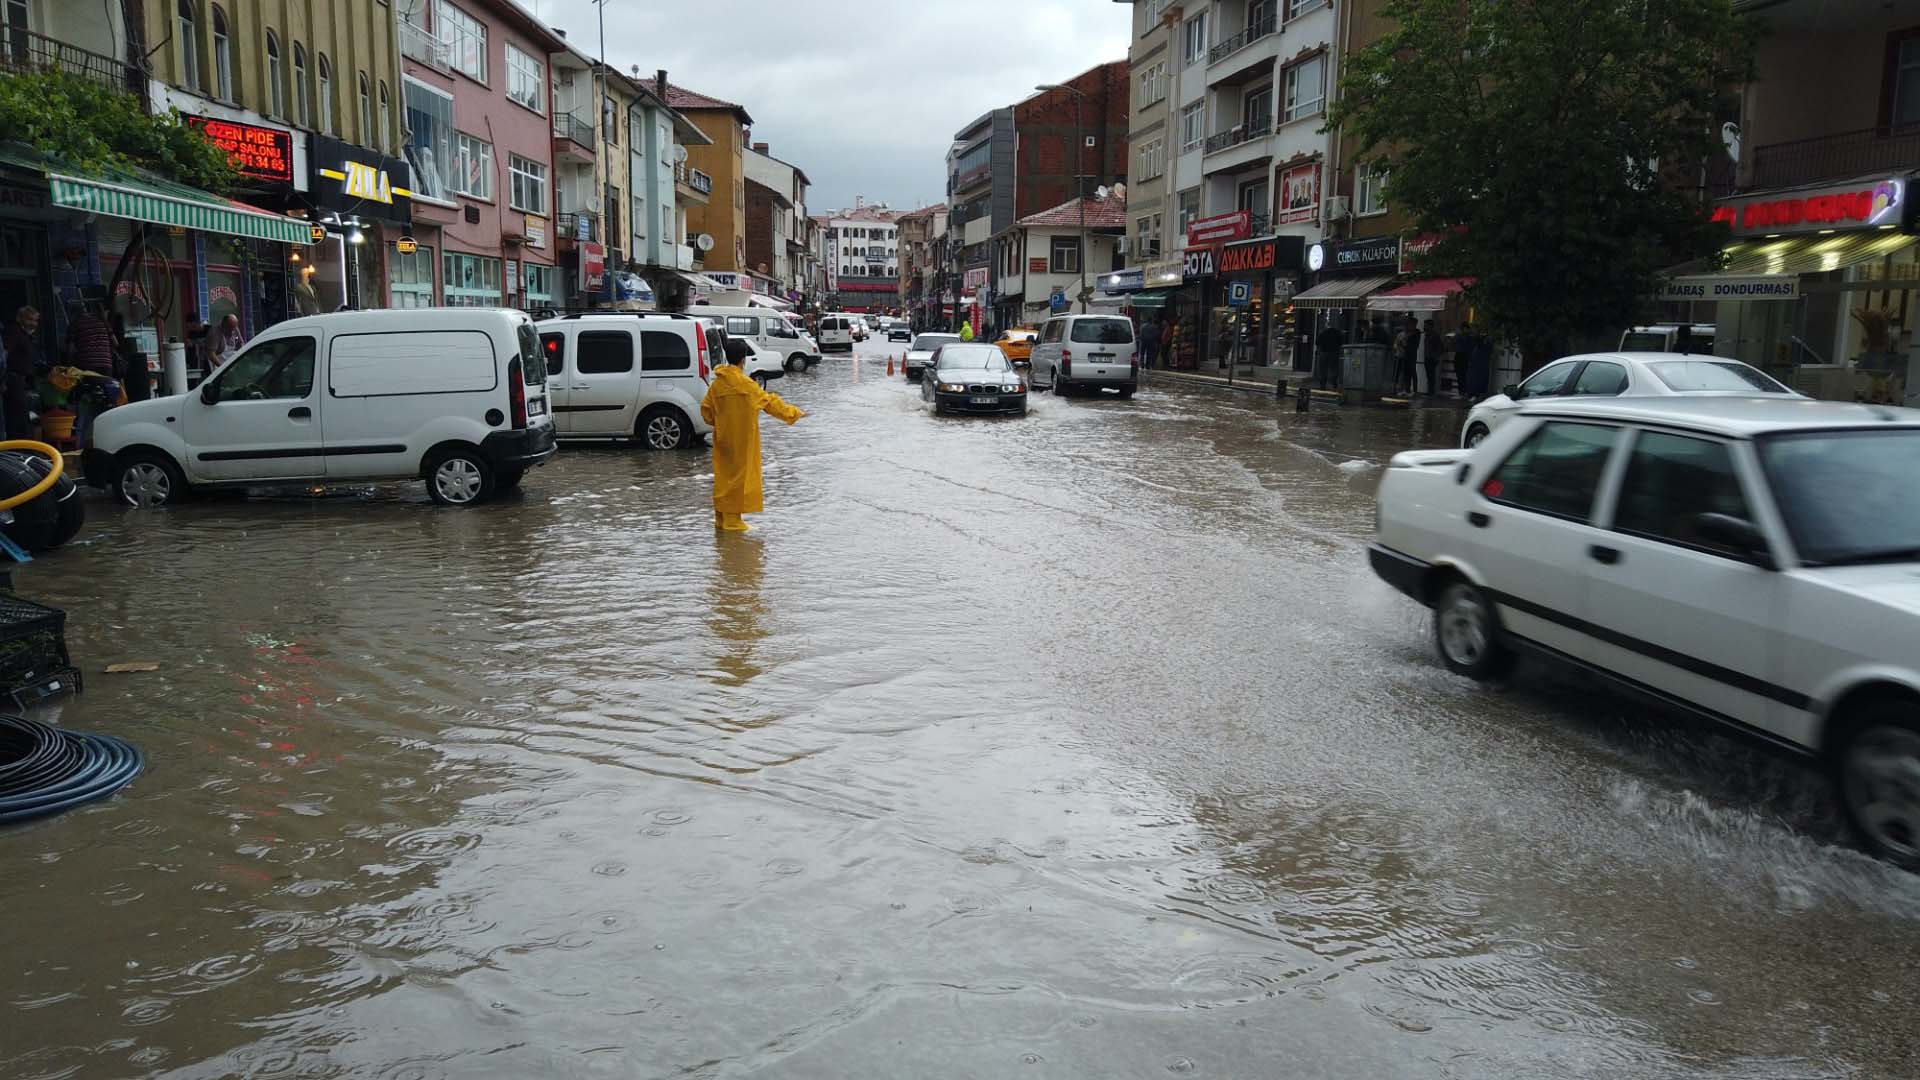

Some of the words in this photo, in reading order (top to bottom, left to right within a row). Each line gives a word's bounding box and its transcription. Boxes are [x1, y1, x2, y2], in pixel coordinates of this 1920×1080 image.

[240, 142, 281, 159] SALONU
[1183, 250, 1214, 276] ROTA
[1220, 243, 1276, 272] AYAKKABI
[704, 273, 738, 287] RKET
[1235, 285, 1245, 298] D
[1714, 282, 1795, 296] DONDURMASI
[1051, 295, 1060, 310] P
